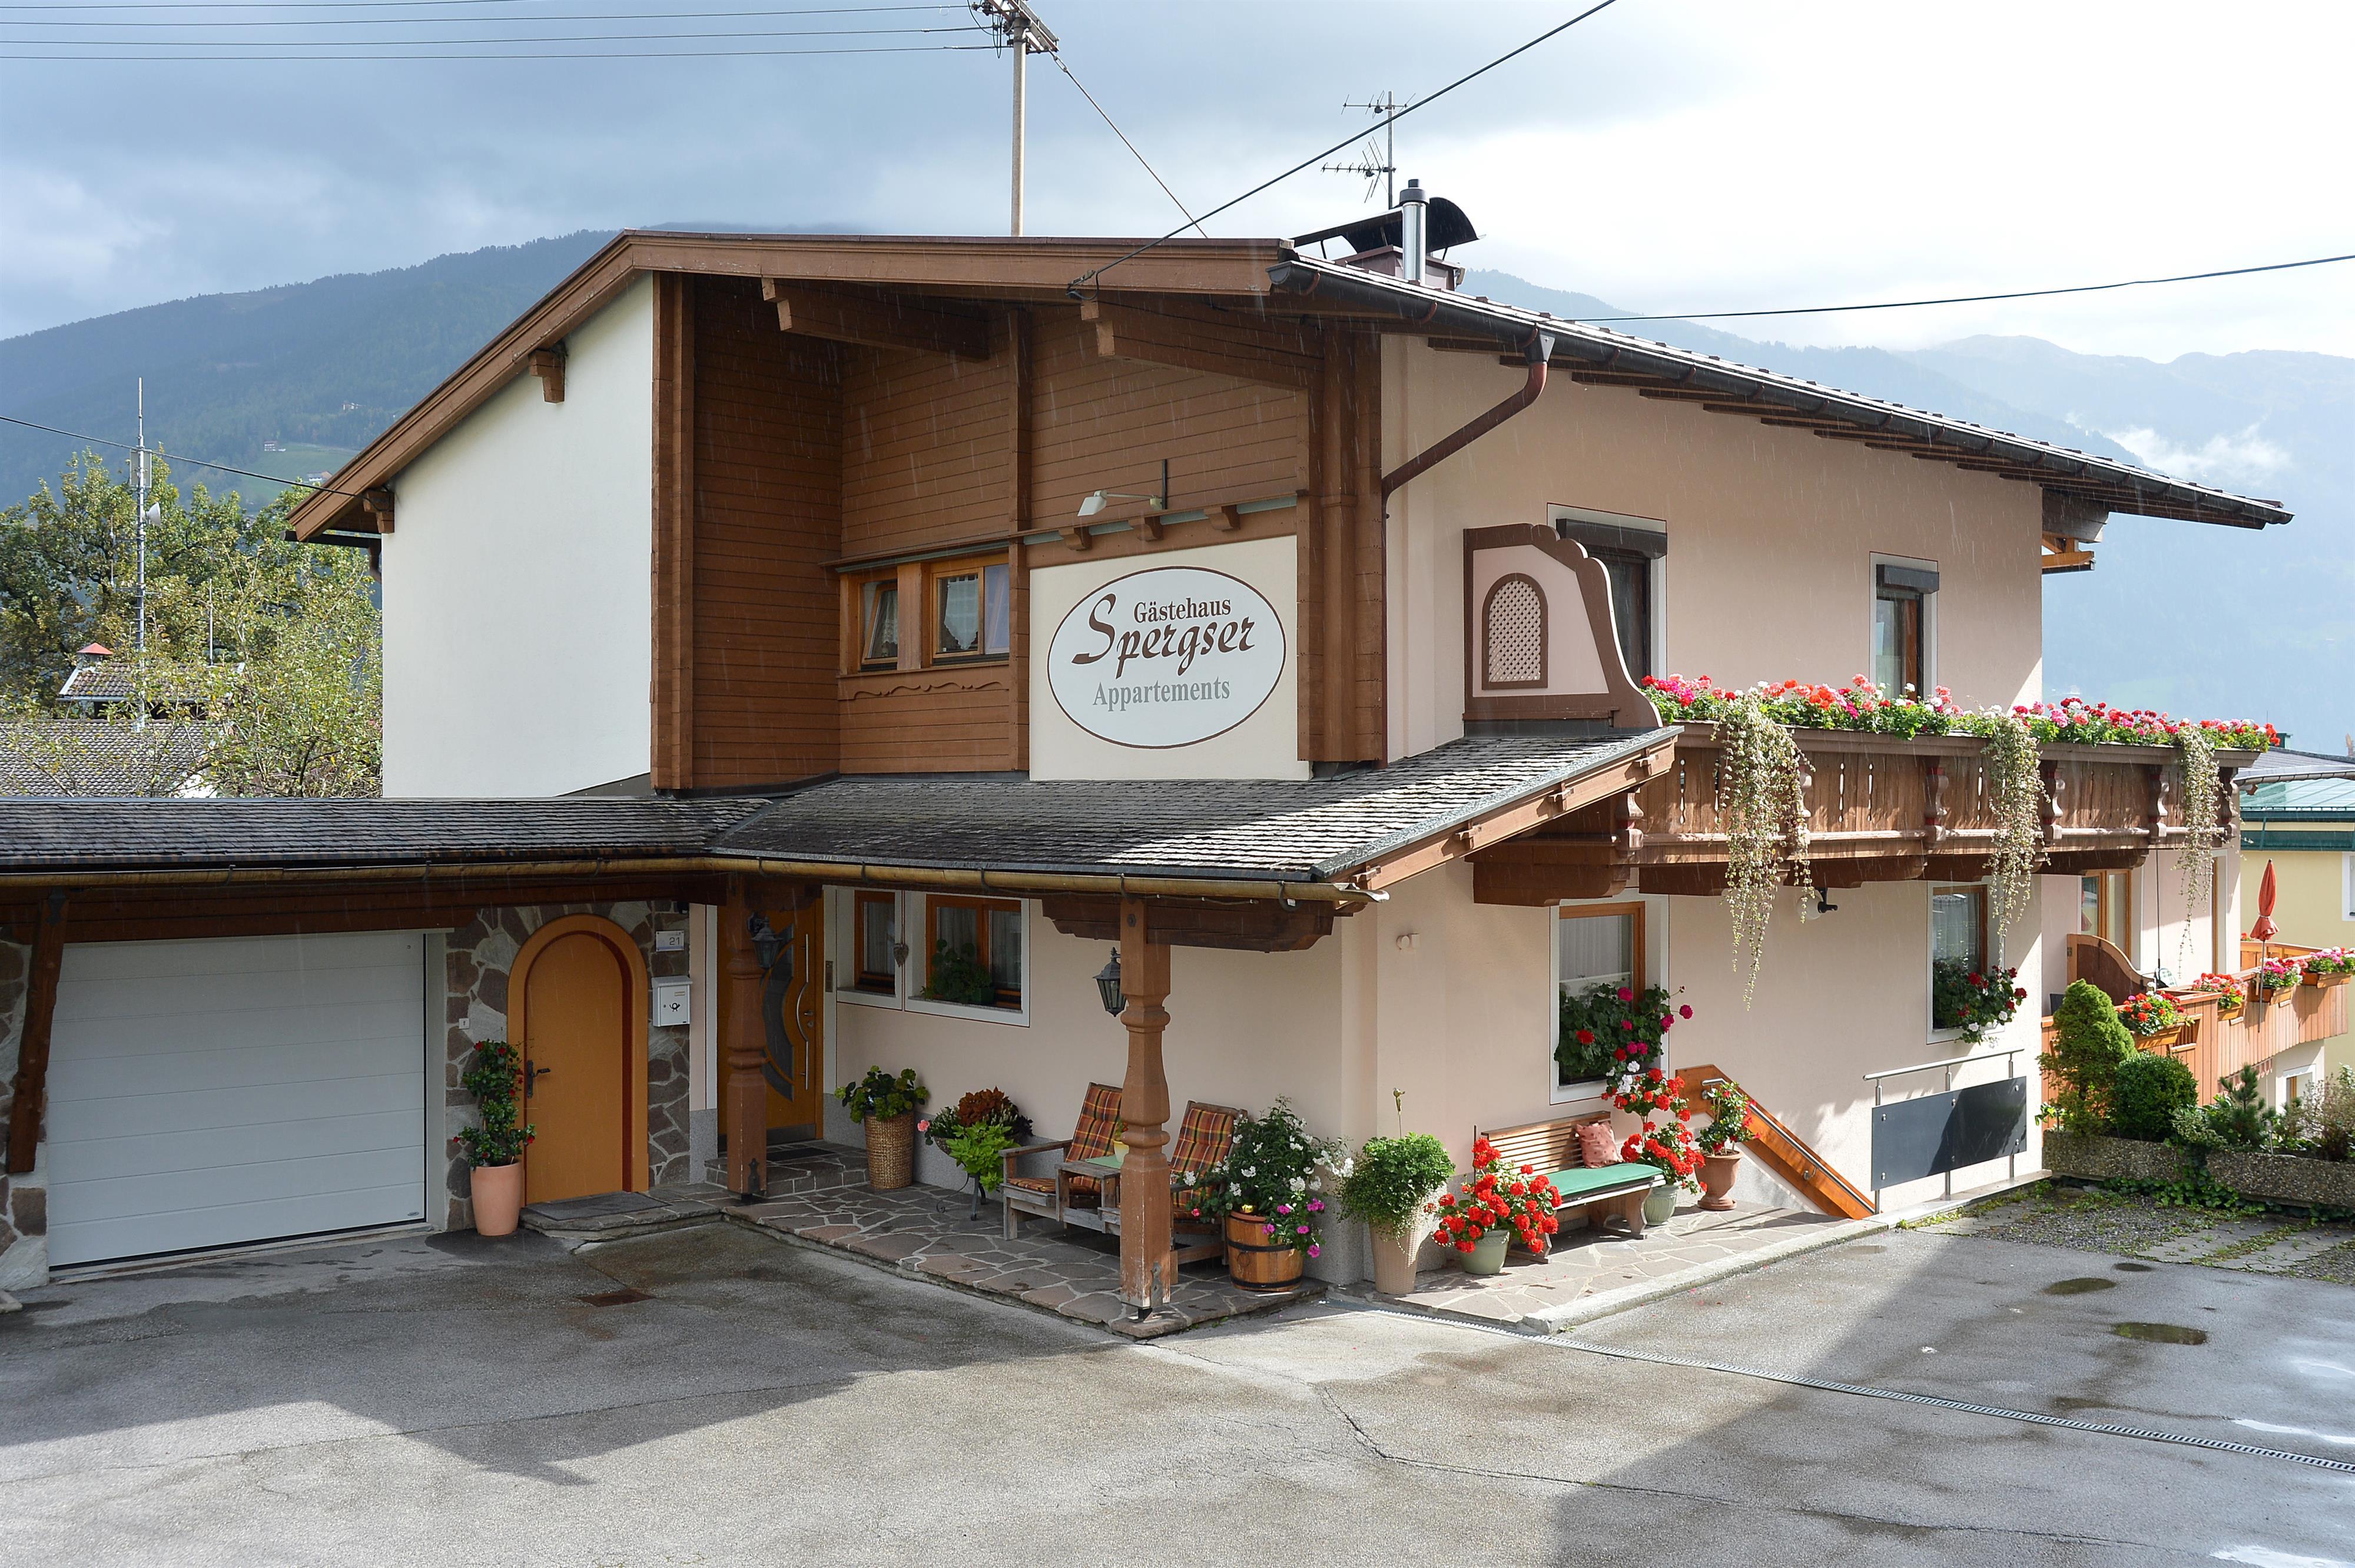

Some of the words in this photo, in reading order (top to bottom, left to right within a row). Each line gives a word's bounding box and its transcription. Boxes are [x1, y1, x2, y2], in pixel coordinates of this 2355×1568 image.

[1134, 598, 1231, 623] Gästehaus
[1072, 594, 1255, 679] Spergser
[1093, 677, 1230, 711] Appartements
[669, 937, 680, 946] 21
